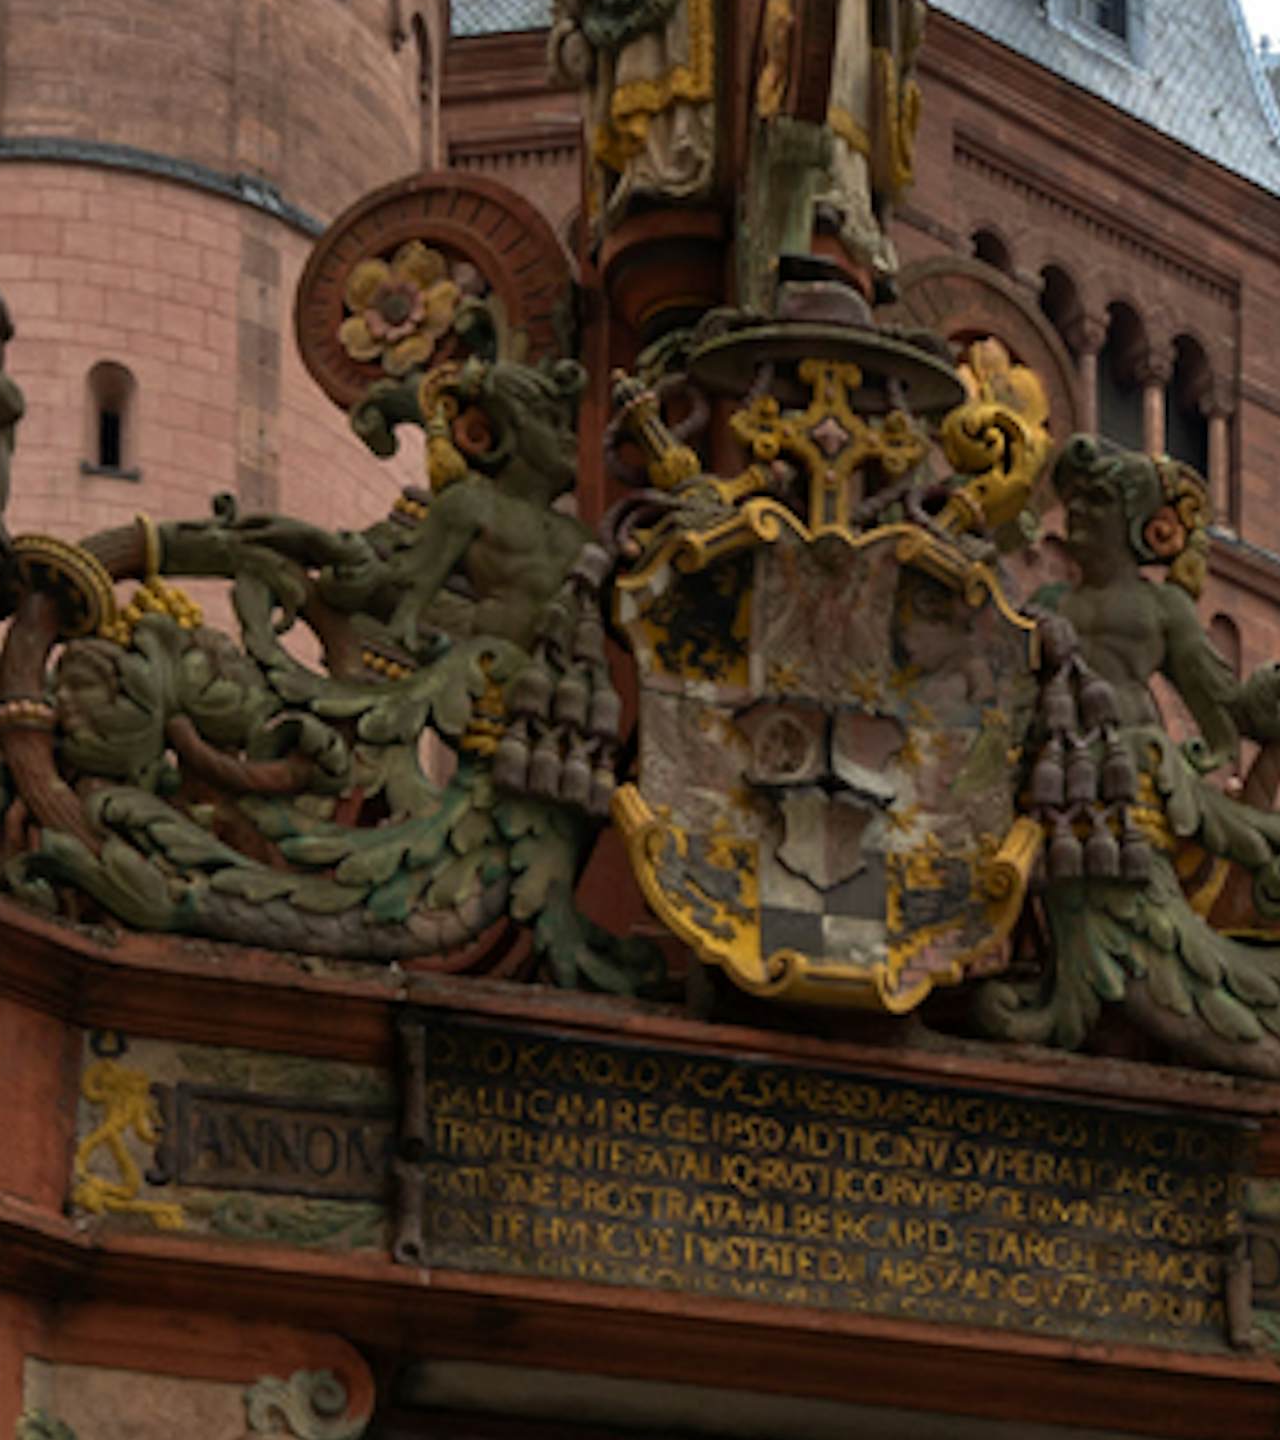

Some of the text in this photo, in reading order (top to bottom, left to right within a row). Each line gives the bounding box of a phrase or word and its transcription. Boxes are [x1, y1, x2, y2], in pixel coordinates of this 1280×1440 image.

[192, 1108, 340, 1176] ANNO
[613, 1098, 708, 1142] REGE
[712, 1110, 784, 1152] IPSO
[788, 1120, 834, 1158] AD
[560, 1176, 743, 1230] PROSTRATA
